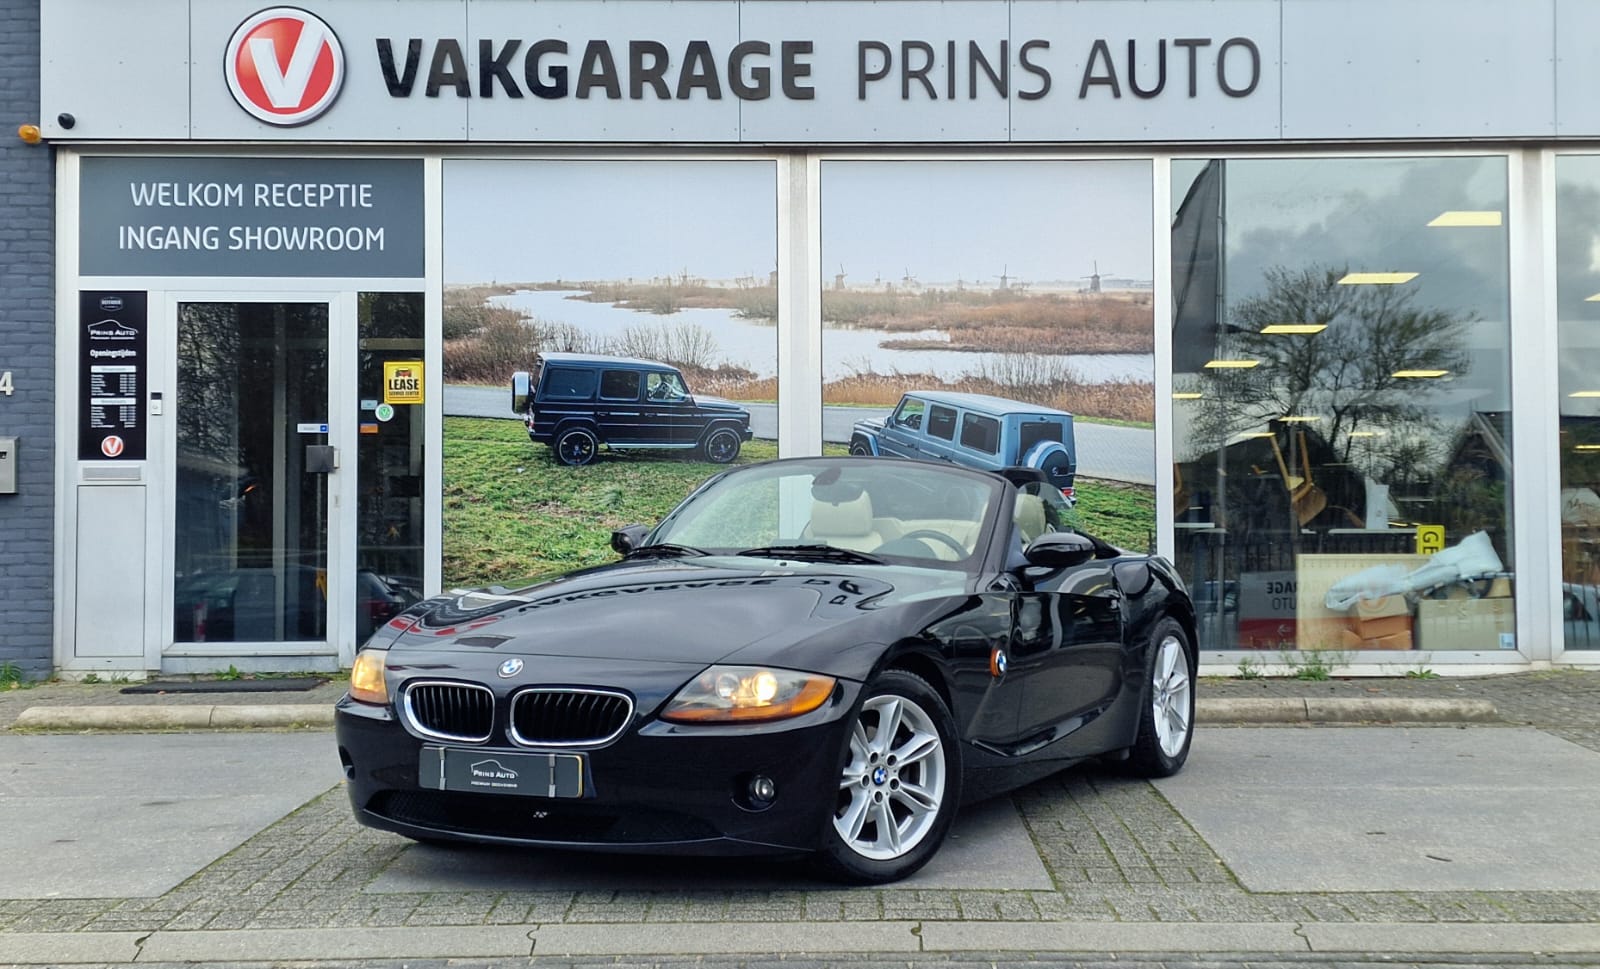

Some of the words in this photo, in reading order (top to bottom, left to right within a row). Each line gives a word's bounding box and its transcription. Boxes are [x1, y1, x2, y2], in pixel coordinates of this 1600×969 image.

[376, 38, 814, 101] VAKGARAGE
[858, 40, 1052, 100] PRINS
[1079, 37, 1261, 99] AUTO
[130, 182, 244, 208] WELKOM
[254, 182, 373, 208] RECEPTIE
[119, 226, 220, 251] INGANG
[228, 226, 385, 252] SHOWROOM
[90, 349, 136, 358] Openingstijden
[389, 379, 419, 390] LEASE
[496, 771, 515, 779] AUTO
